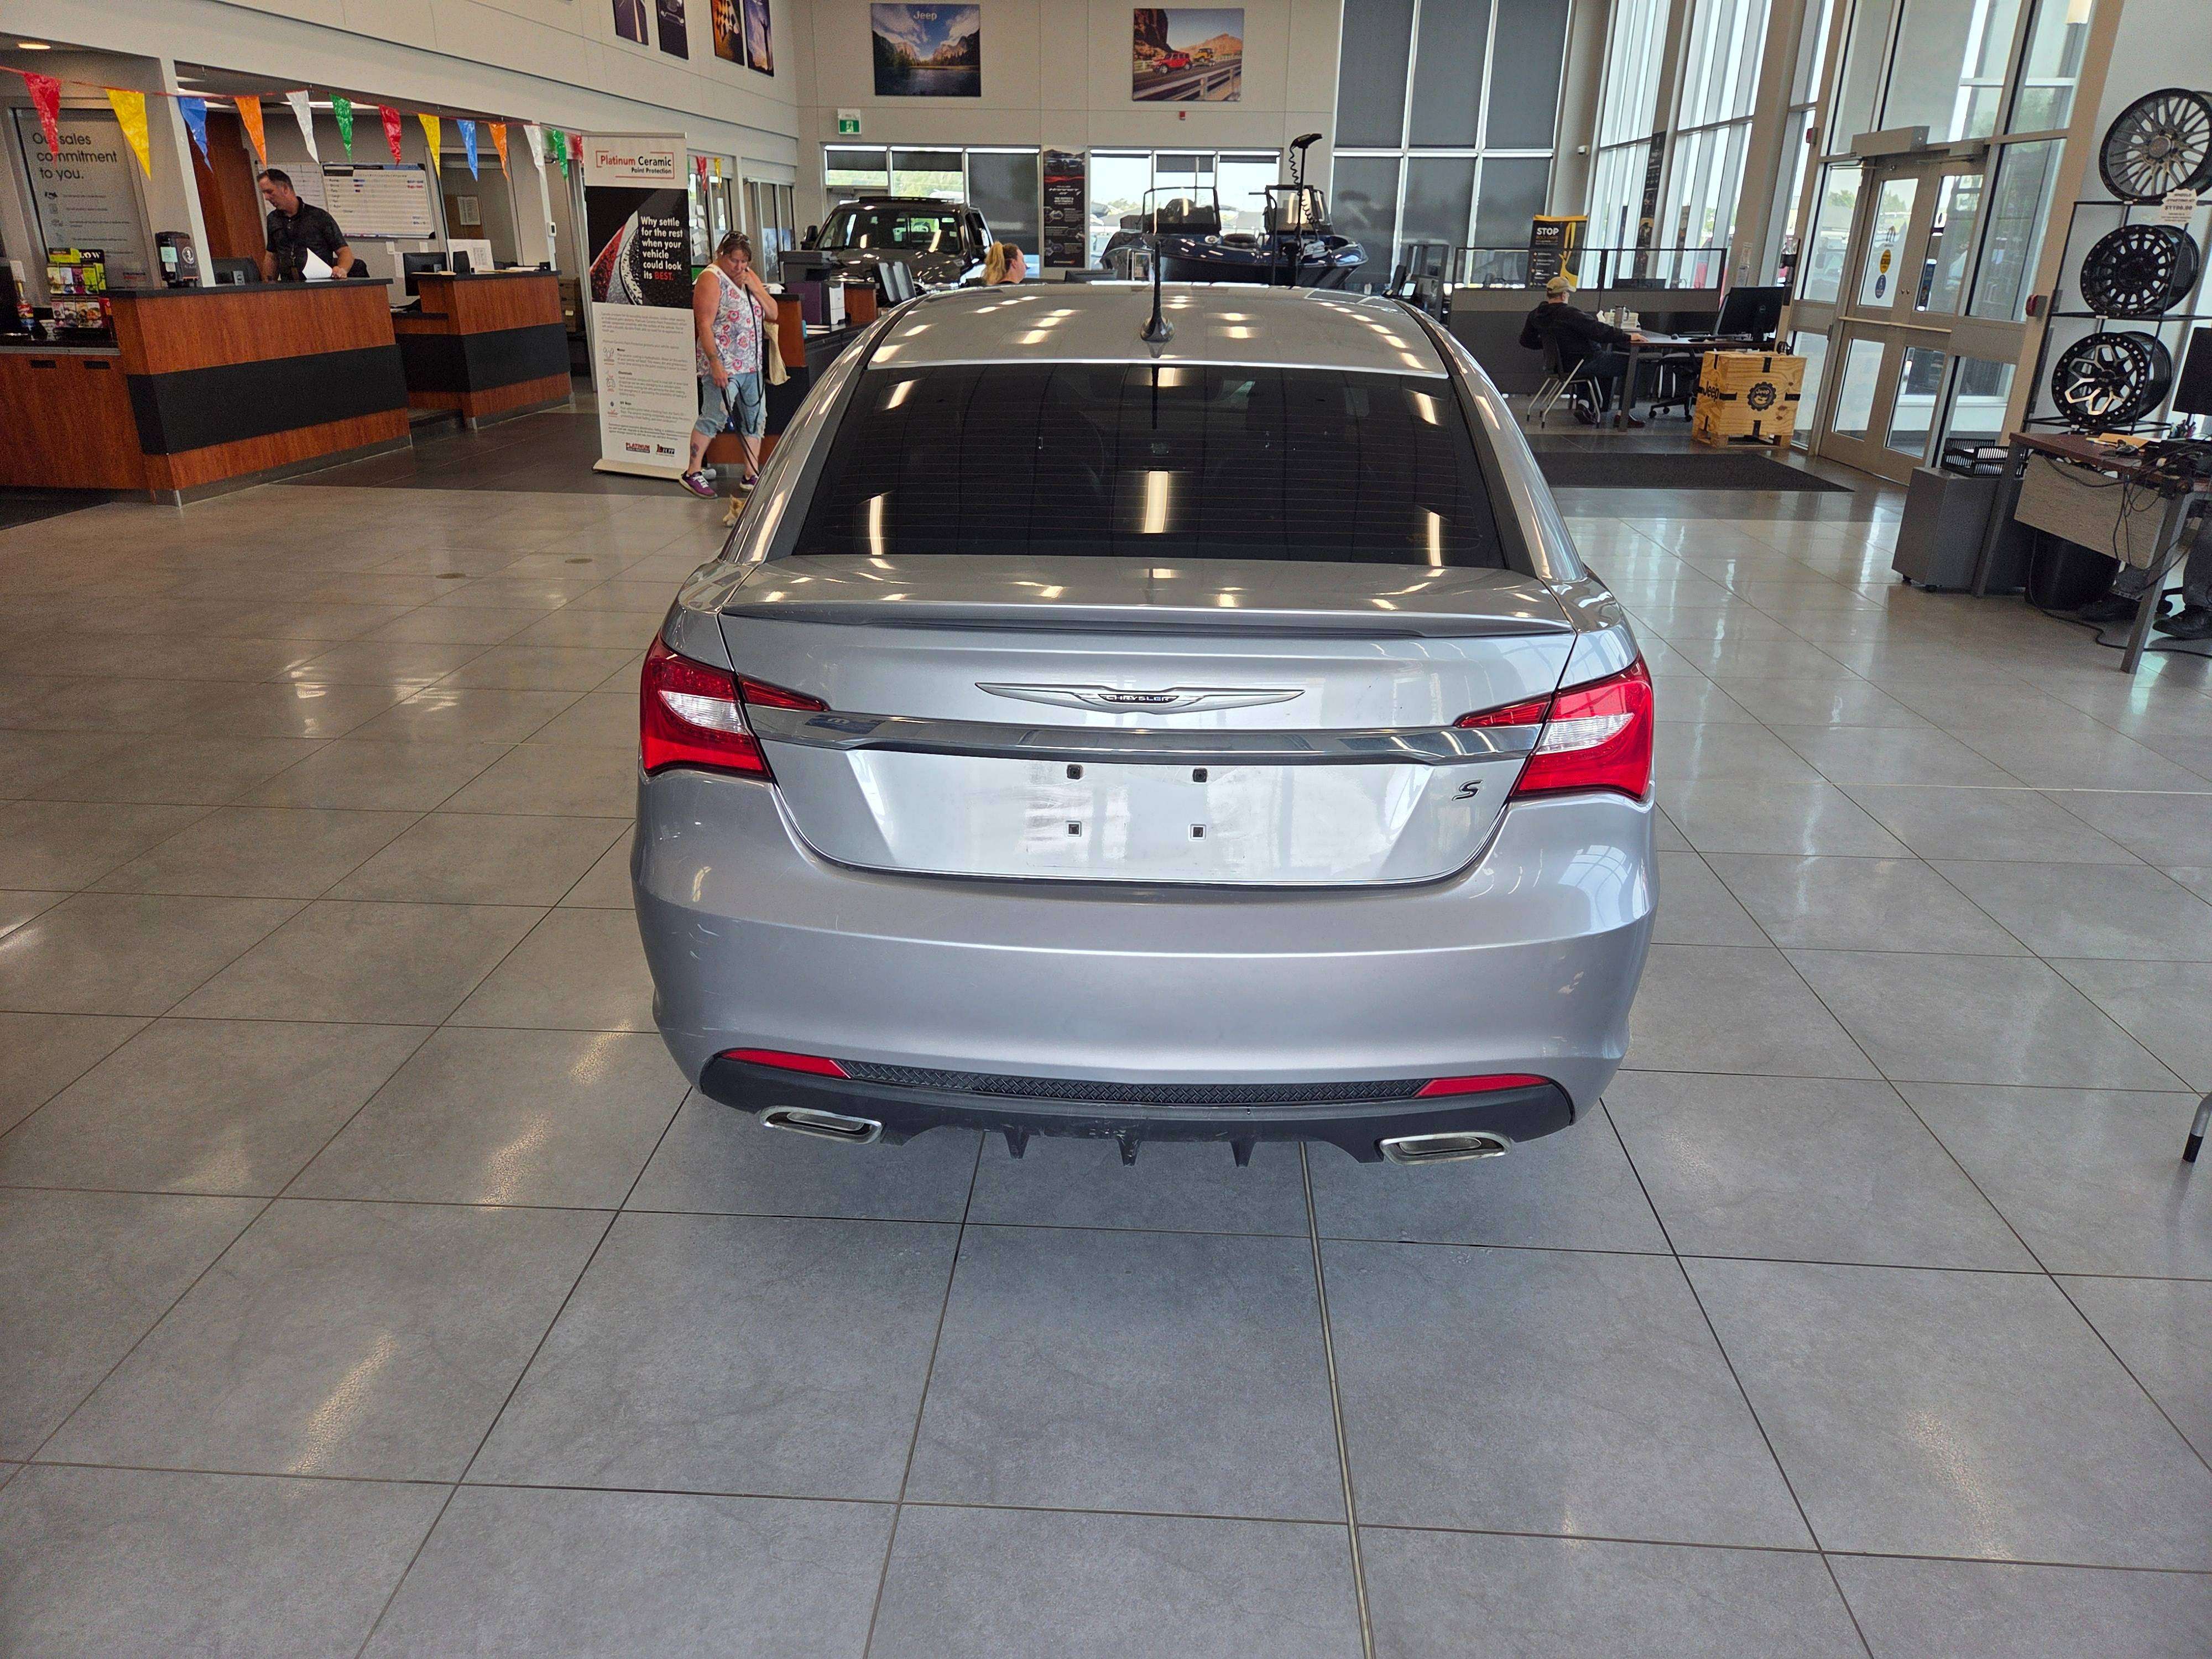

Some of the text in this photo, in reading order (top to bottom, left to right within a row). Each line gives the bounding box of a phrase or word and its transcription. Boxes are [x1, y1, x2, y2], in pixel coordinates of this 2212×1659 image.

[913, 11, 937, 21] Jeep
[59, 133, 91, 144] sales
[601, 155, 671, 166] Platinum Ceramic
[40, 168, 84, 181] to you.
[641, 216, 680, 228] Why settle
[641, 227, 683, 238] for the rest
[1536, 227, 1559, 236] STOP
[641, 238, 681, 250] when your
[642, 248, 669, 259] vehicle
[643, 260, 682, 270] could look
[654, 272, 674, 280] BEST.
[1452, 779, 1483, 801] S
